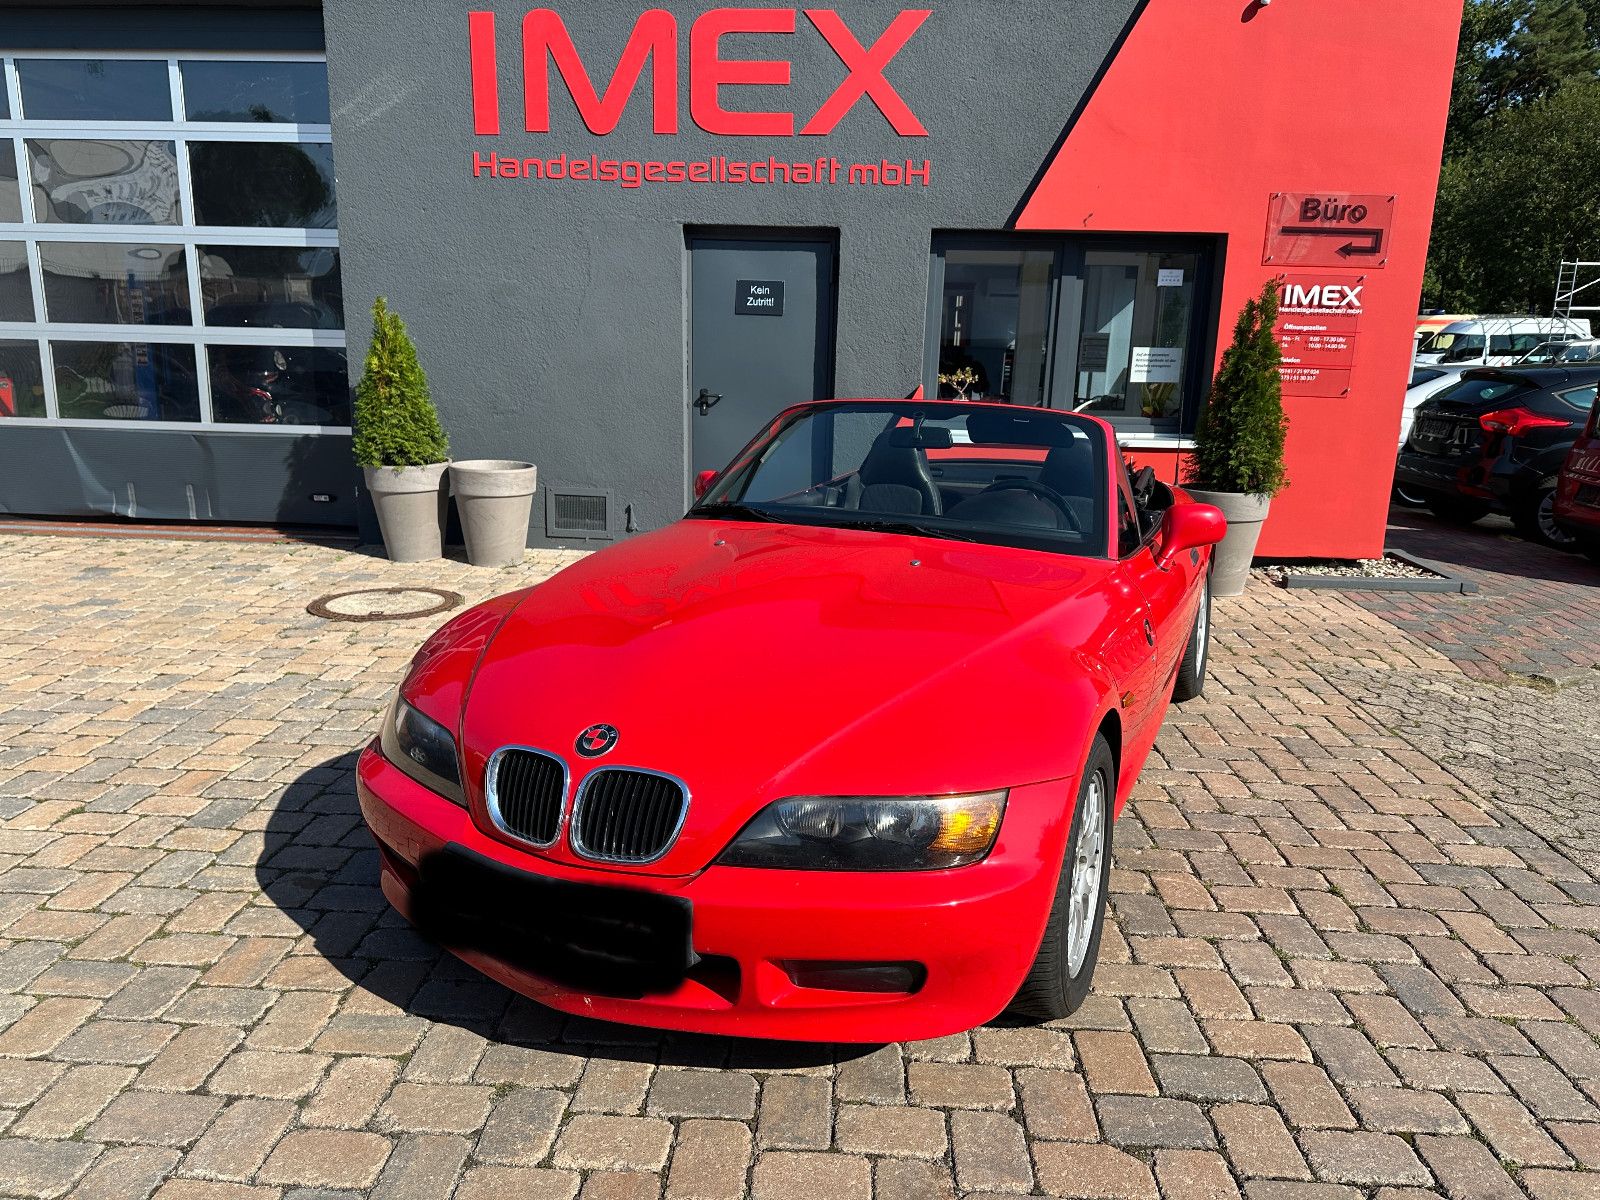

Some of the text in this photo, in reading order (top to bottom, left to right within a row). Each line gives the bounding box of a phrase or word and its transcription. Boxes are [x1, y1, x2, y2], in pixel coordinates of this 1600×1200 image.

[468, 8, 933, 136] IMEX
[474, 151, 931, 188] Handelsgesellschaft mbH
[1303, 198, 1368, 221] Büro
[750, 285, 770, 295] Kein
[1284, 284, 1363, 306] IMEX
[747, 297, 774, 306] Zutritt!
[1279, 306, 1346, 314] Handelsgesellschaft
